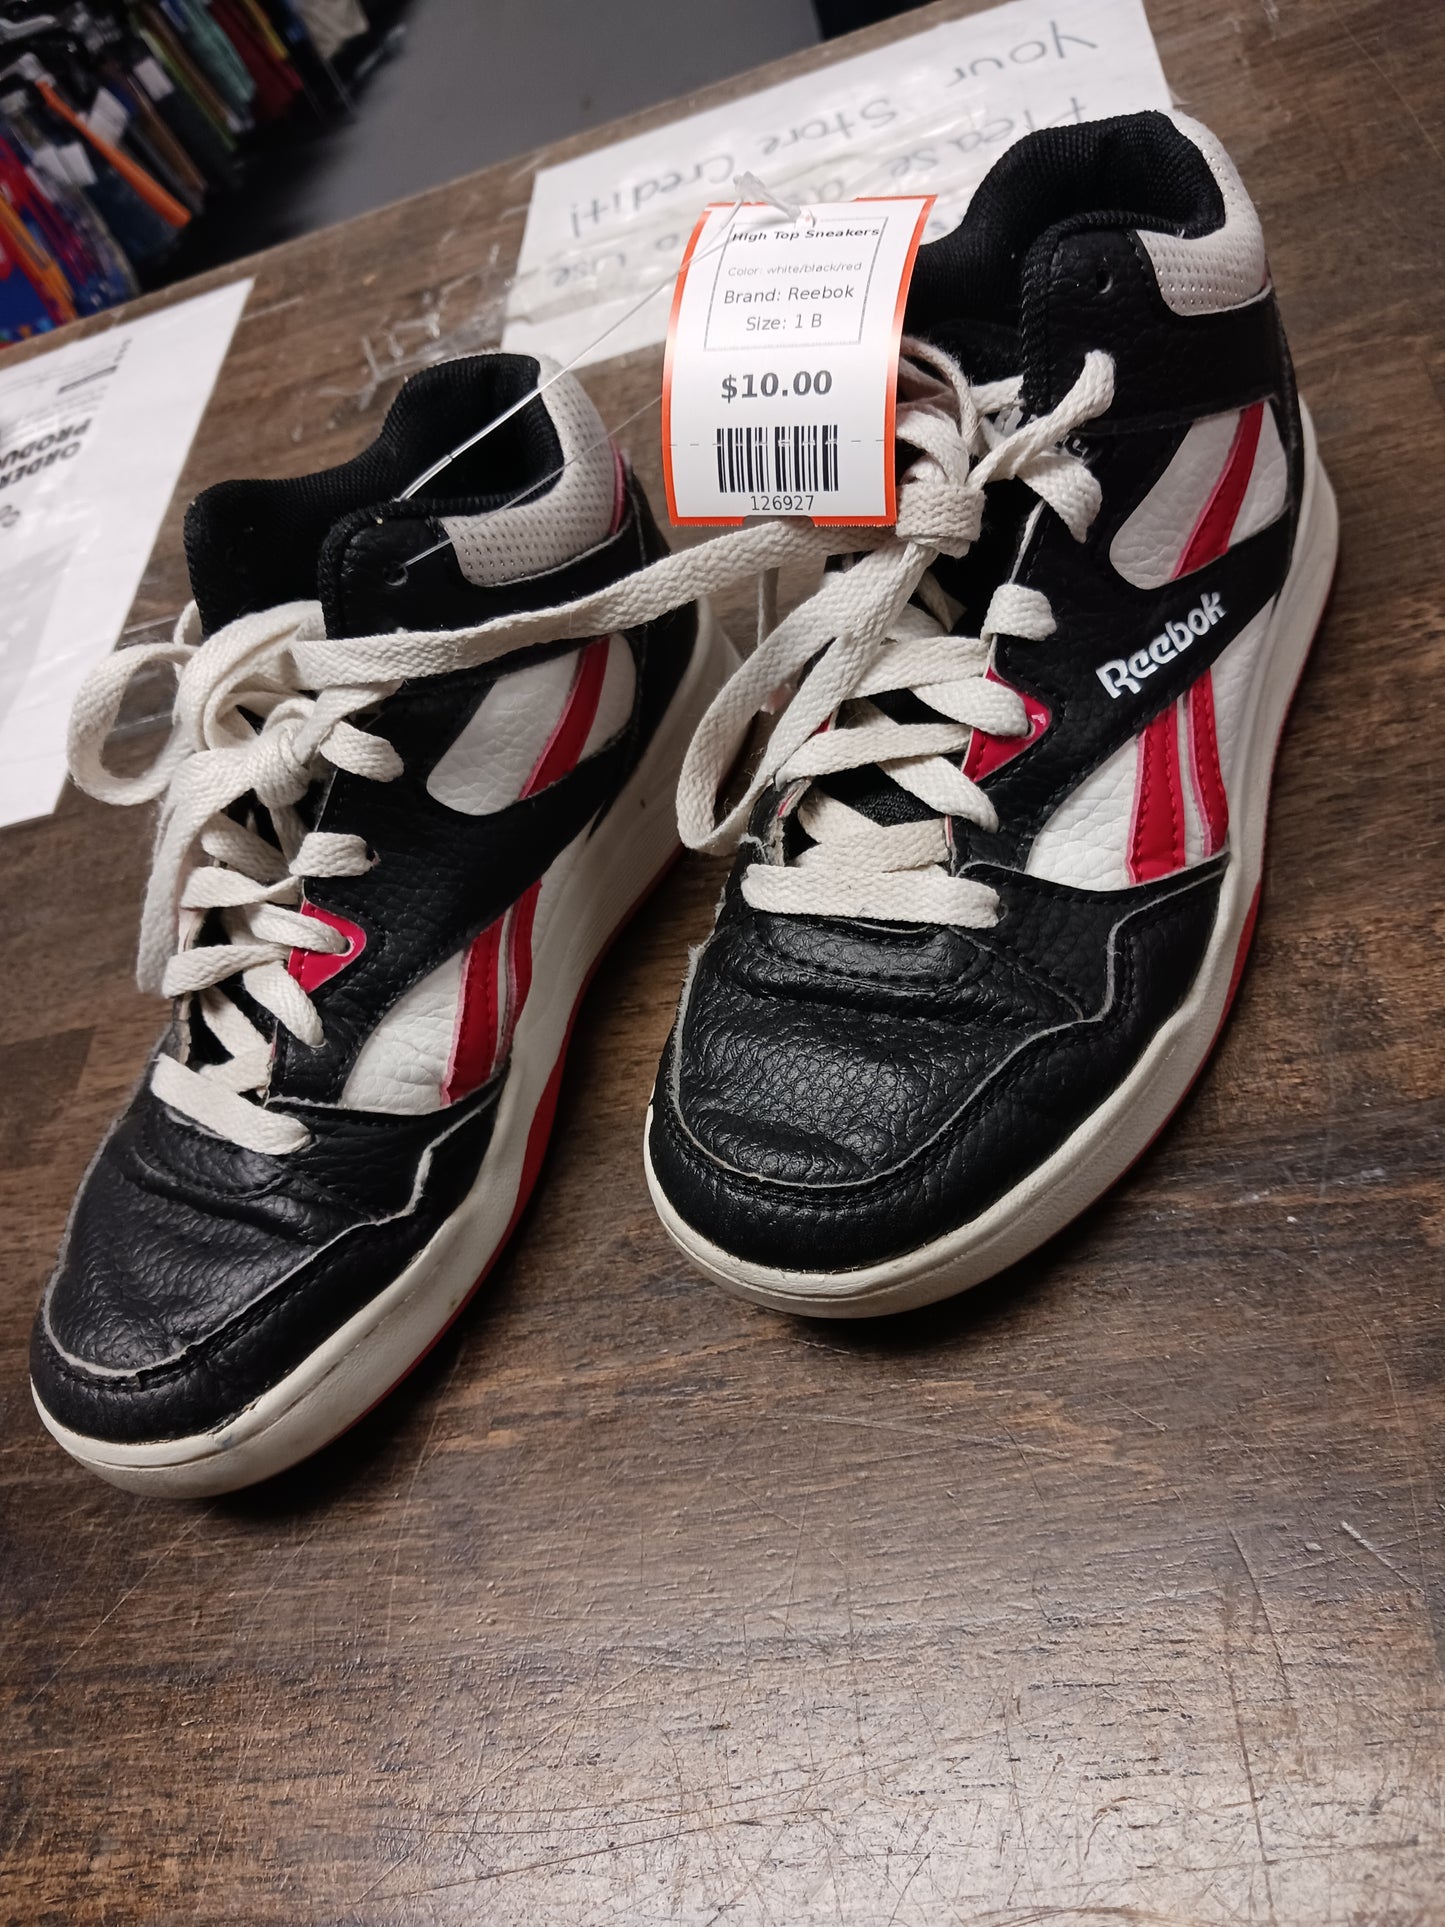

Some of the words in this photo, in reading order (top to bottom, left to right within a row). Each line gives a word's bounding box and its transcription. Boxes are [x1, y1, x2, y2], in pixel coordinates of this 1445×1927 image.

[756, 98, 898, 156] Store
[570, 154, 734, 239] Credit!
[732, 232, 767, 243] High
[774, 231, 800, 241] Top
[804, 228, 880, 239] Sneakers
[728, 266, 763, 277] Color:
[766, 261, 863, 275] white/black/red
[724, 287, 781, 304] Brand:
[788, 284, 855, 301] Reebok
[745, 315, 787, 331] Size:
[794, 313, 803, 329] 1
[811, 313, 822, 328] B
[721, 369, 833, 404] $10.00
[750, 495, 815, 511] 126927
[1095, 591, 1227, 699] Reebok
